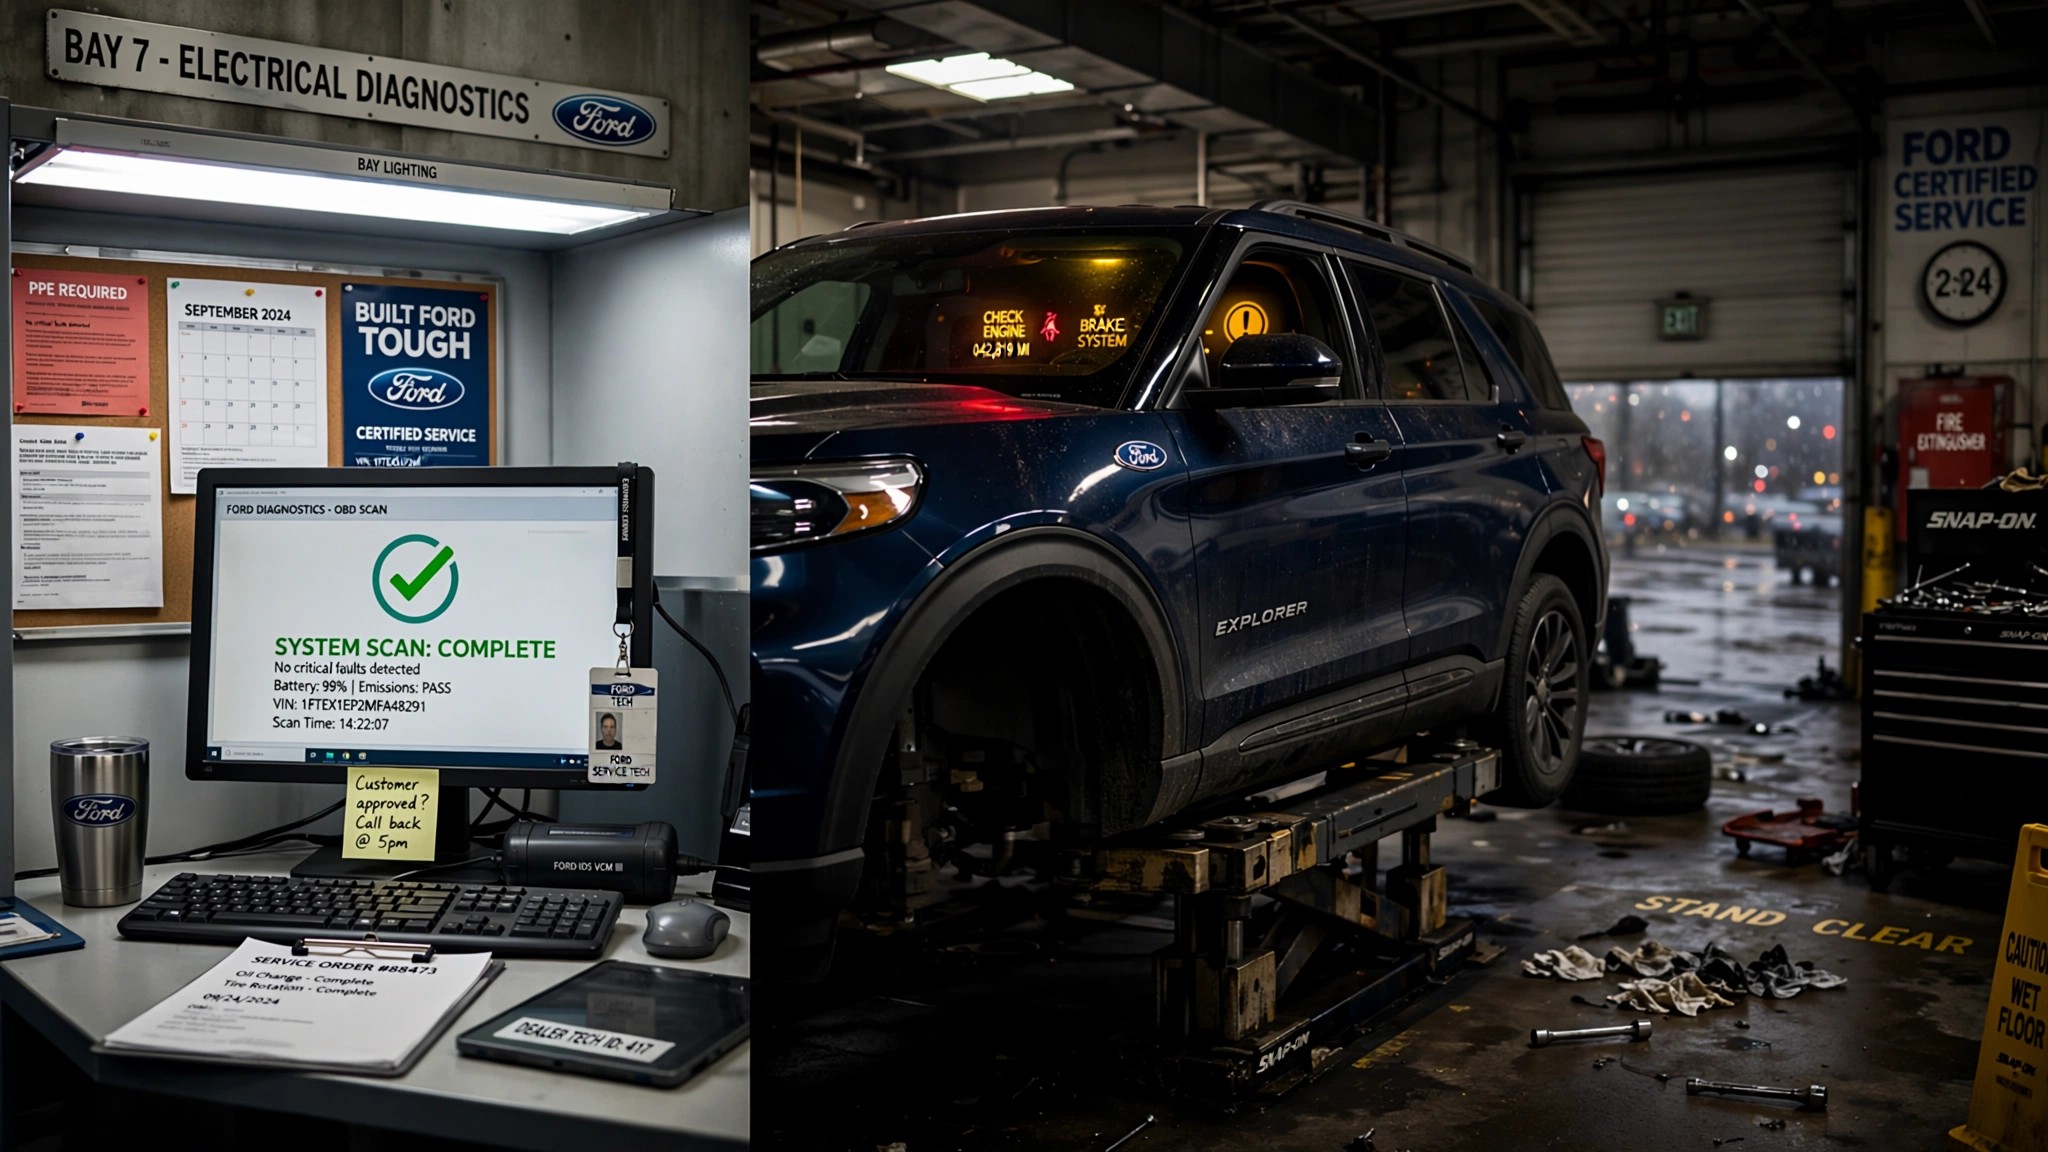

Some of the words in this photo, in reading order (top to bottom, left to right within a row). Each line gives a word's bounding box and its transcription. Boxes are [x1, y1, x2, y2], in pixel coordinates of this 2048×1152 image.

[65, 28, 123, 69] BAY
[132, 38, 150, 72] 7
[180, 44, 347, 100] ELECTRICAL
[356, 68, 530, 124] DIAGNOSTICS
[573, 100, 637, 138] Ford
[1903, 126, 2010, 166] FORD
[357, 157, 380, 173] BAY
[384, 161, 437, 179] LIGHTING
[1895, 165, 2038, 198] CERTIFIED
[1895, 197, 2027, 231] SERVICE
[29, 281, 55, 297] PPE
[59, 283, 128, 301] REQUIRED
[1936, 267, 1992, 297] 2:24
[184, 303, 258, 320] SEPTEMBER
[261, 308, 292, 322] 2024
[355, 301, 415, 325] BUILT
[419, 305, 476, 328] FORD
[983, 309, 1024, 324] CHECK
[983, 324, 1026, 338] ENGINE
[1080, 318, 1126, 333] BRAKE
[358, 326, 471, 360] TOUGH
[1078, 334, 1127, 348] SYSTEM
[386, 372, 448, 404] Ford
[1936, 412, 1964, 432] FIRE
[356, 426, 423, 441] CERTIFIED
[424, 428, 476, 443] SERVICE
[1128, 444, 1160, 465] Ford
[226, 504, 254, 515] FORD
[256, 504, 326, 515] DIAGNOSTICS
[334, 504, 357, 515] OBD
[359, 504, 388, 515] SCAN
[1215, 600, 1308, 637] EXPLORER
[275, 637, 360, 656] SYSTEM
[366, 638, 431, 657] SCAN:
[438, 639, 556, 659] COMPLETE
[274, 661, 291, 673] No
[294, 661, 333, 674] critical
[336, 661, 366, 675] faults
[369, 662, 421, 675] detected
[274, 679, 319, 694] Battery:
[322, 680, 347, 692] 99%
[359, 681, 419, 693] Emissions:
[422, 682, 451, 694] PASS
[273, 698, 298, 710] VIN:
[272, 716, 300, 729] Scan
[304, 717, 335, 730] Time:
[340, 718, 389, 731] 14:22:07
[355, 774, 419, 791] Customer
[73, 799, 125, 821] Ford
[355, 815, 382, 829] Call
[389, 815, 421, 830] back
[355, 833, 371, 849] @
[378, 834, 408, 854] 5pm
[553, 861, 577, 871] FORD
[579, 862, 592, 871] IDS
[594, 862, 613, 872] VCM
[1635, 895, 1787, 927] STAND
[1812, 918, 1974, 955] CLEAR
[2006, 931, 2048, 975] CAUTIO
[250, 956, 317, 968] SERVICE
[318, 960, 375, 972] ORDER
[378, 964, 438, 975] #88473
[224, 979, 247, 988] Tire
[250, 981, 304, 992] Rotation
[316, 985, 377, 997] Complete
[235, 970, 253, 978] Oil
[256, 971, 303, 982] Change
[314, 975, 375, 987] Complete
[2011, 977, 2041, 1012] WET
[514, 1022, 569, 1039] DEALER
[567, 1030, 602, 1046] TECH
[1997, 1006, 2046, 1049] FLOOR
